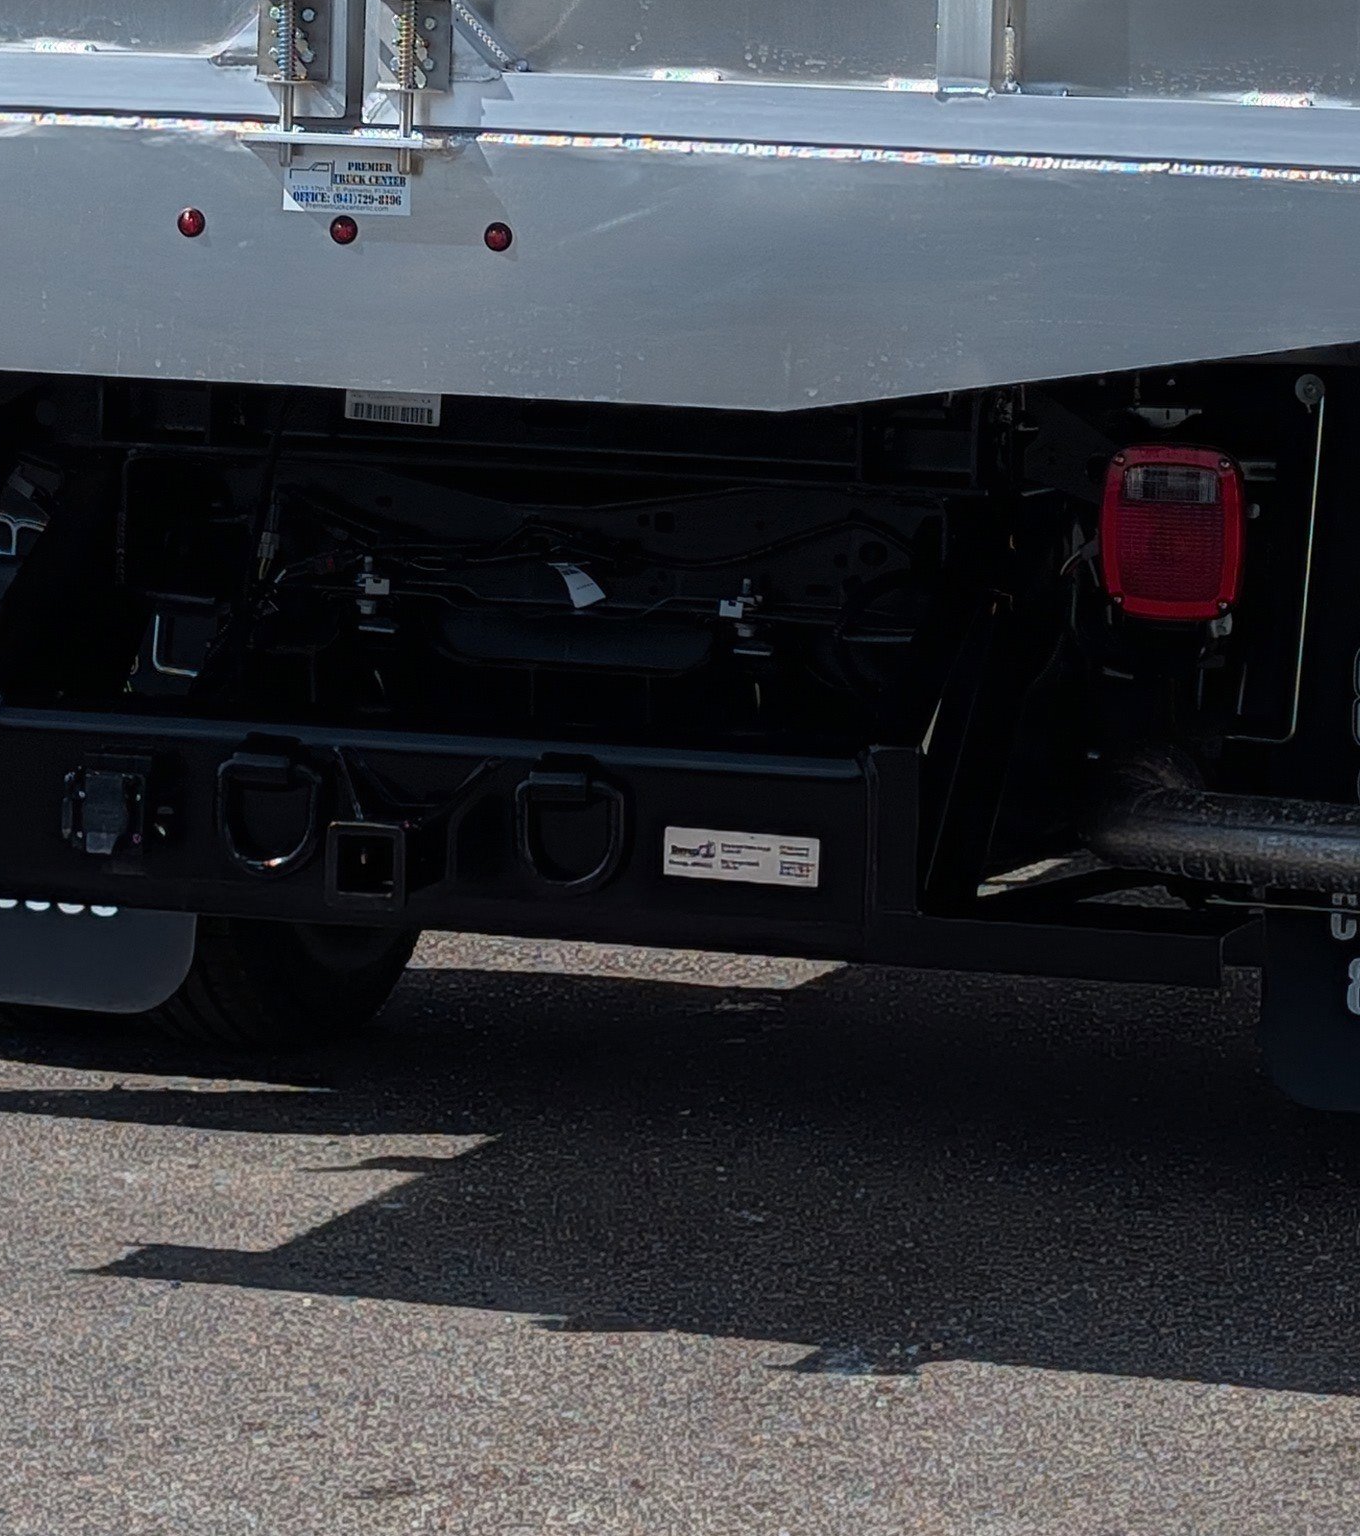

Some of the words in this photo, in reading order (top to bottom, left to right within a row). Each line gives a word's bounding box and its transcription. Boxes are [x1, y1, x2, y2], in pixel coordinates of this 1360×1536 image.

[347, 161, 393, 173] PREMIER
[334, 173, 366, 185] TRUCK
[368, 175, 407, 188] CENTER
[293, 191, 331, 203] OFFICE:
